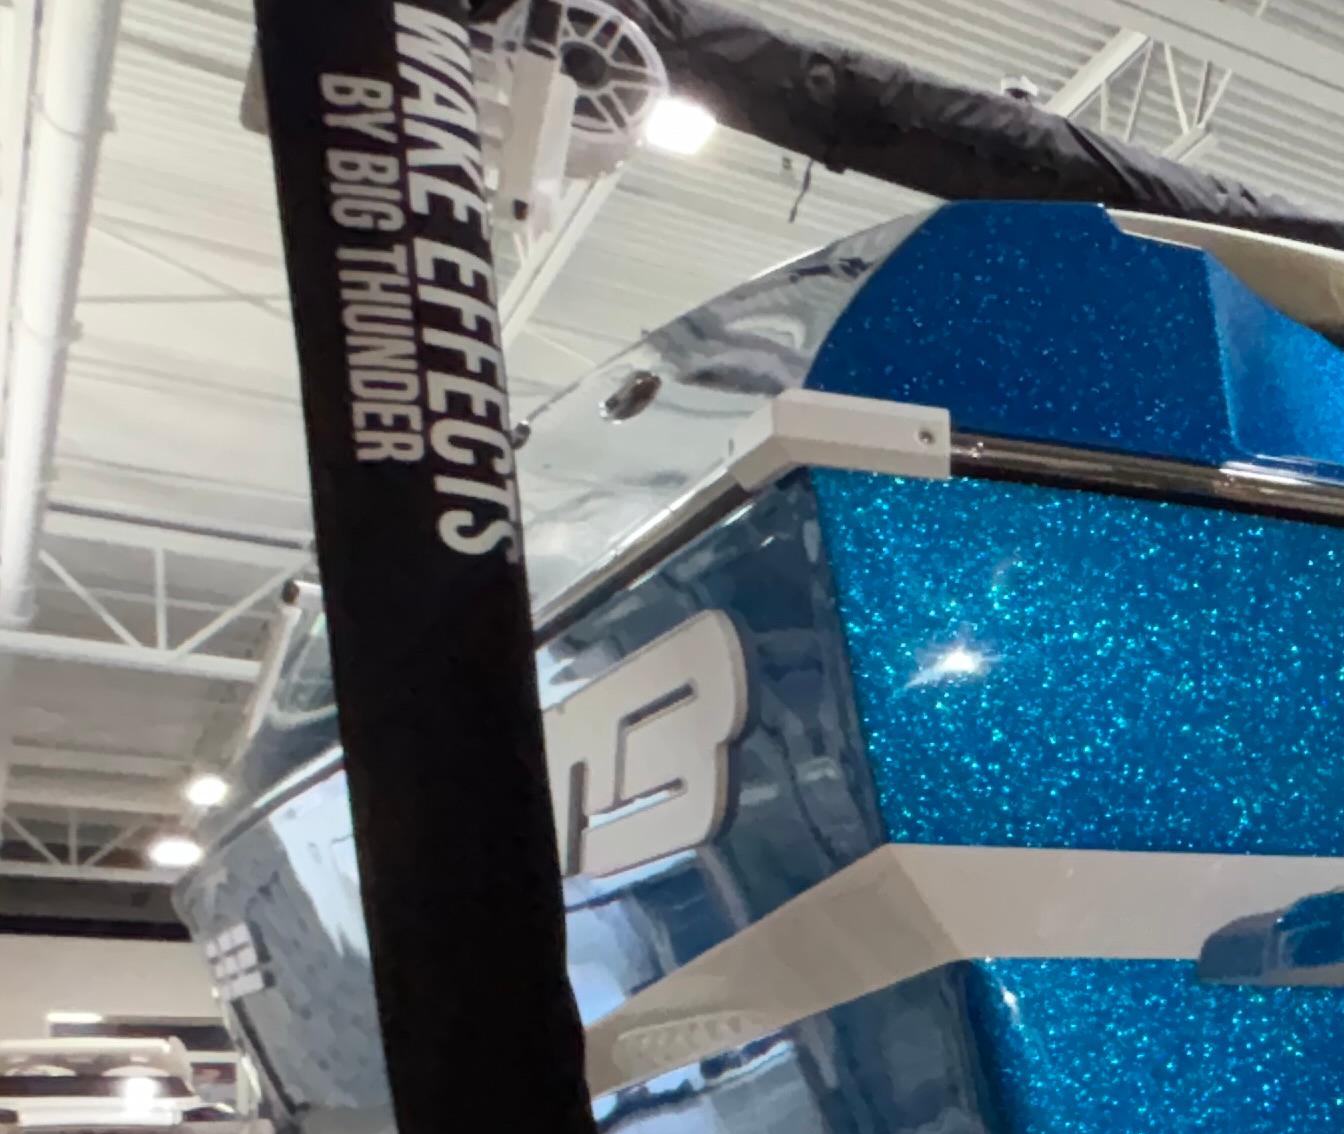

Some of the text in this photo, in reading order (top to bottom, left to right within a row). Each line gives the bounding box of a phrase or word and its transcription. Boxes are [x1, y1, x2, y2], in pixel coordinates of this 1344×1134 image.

[318, 72, 426, 463] BY BIG THUNDER
[392, 1, 521, 565] WAKE EFFECTS
